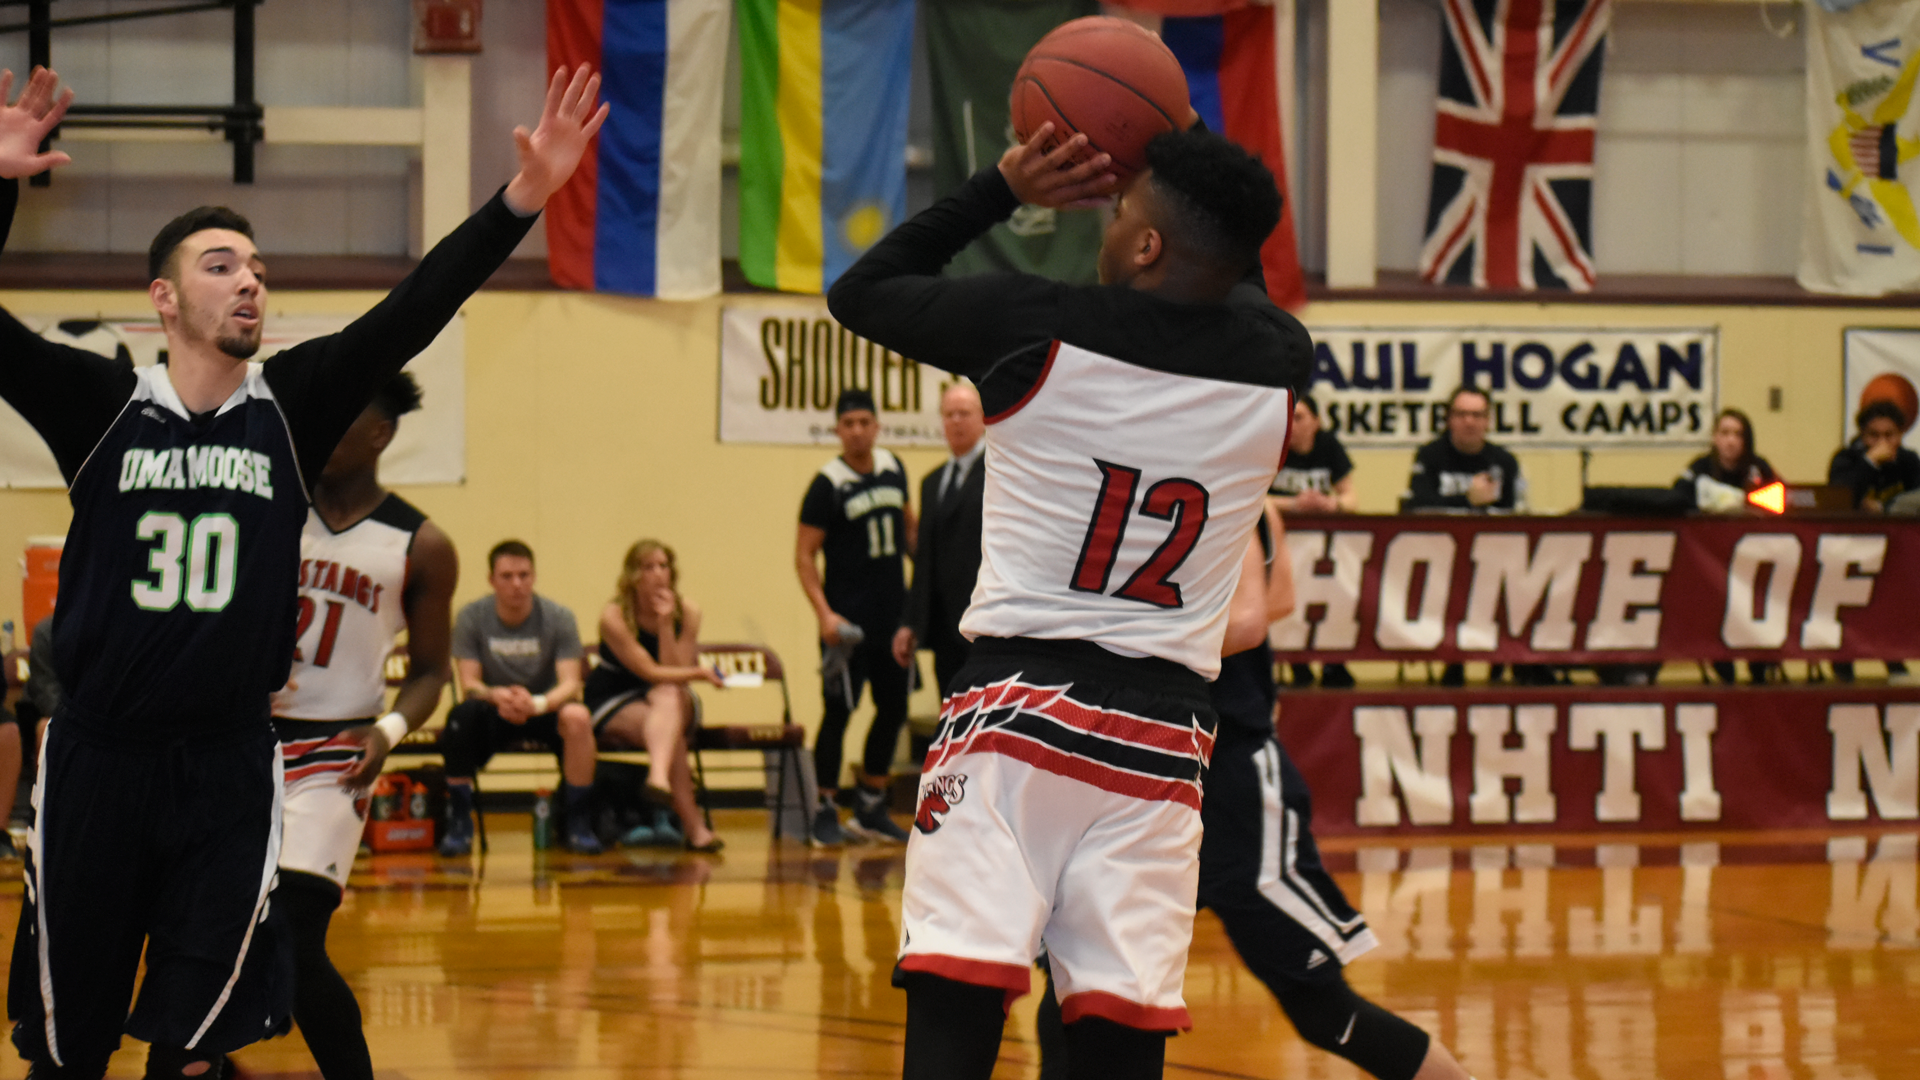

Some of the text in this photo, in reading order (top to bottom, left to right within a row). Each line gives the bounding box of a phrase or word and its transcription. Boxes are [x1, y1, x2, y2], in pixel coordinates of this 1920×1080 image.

[1310, 340, 1703, 392] AUL HOGAN
[1327, 401, 1703, 434] SKETBLL CAMPS
[130, 510, 240, 613] 30
[1069, 457, 1210, 609] 12
[299, 558, 384, 615] STANGS
[1267, 530, 1889, 652] HOME OF
[1353, 703, 1722, 827] NHTI
